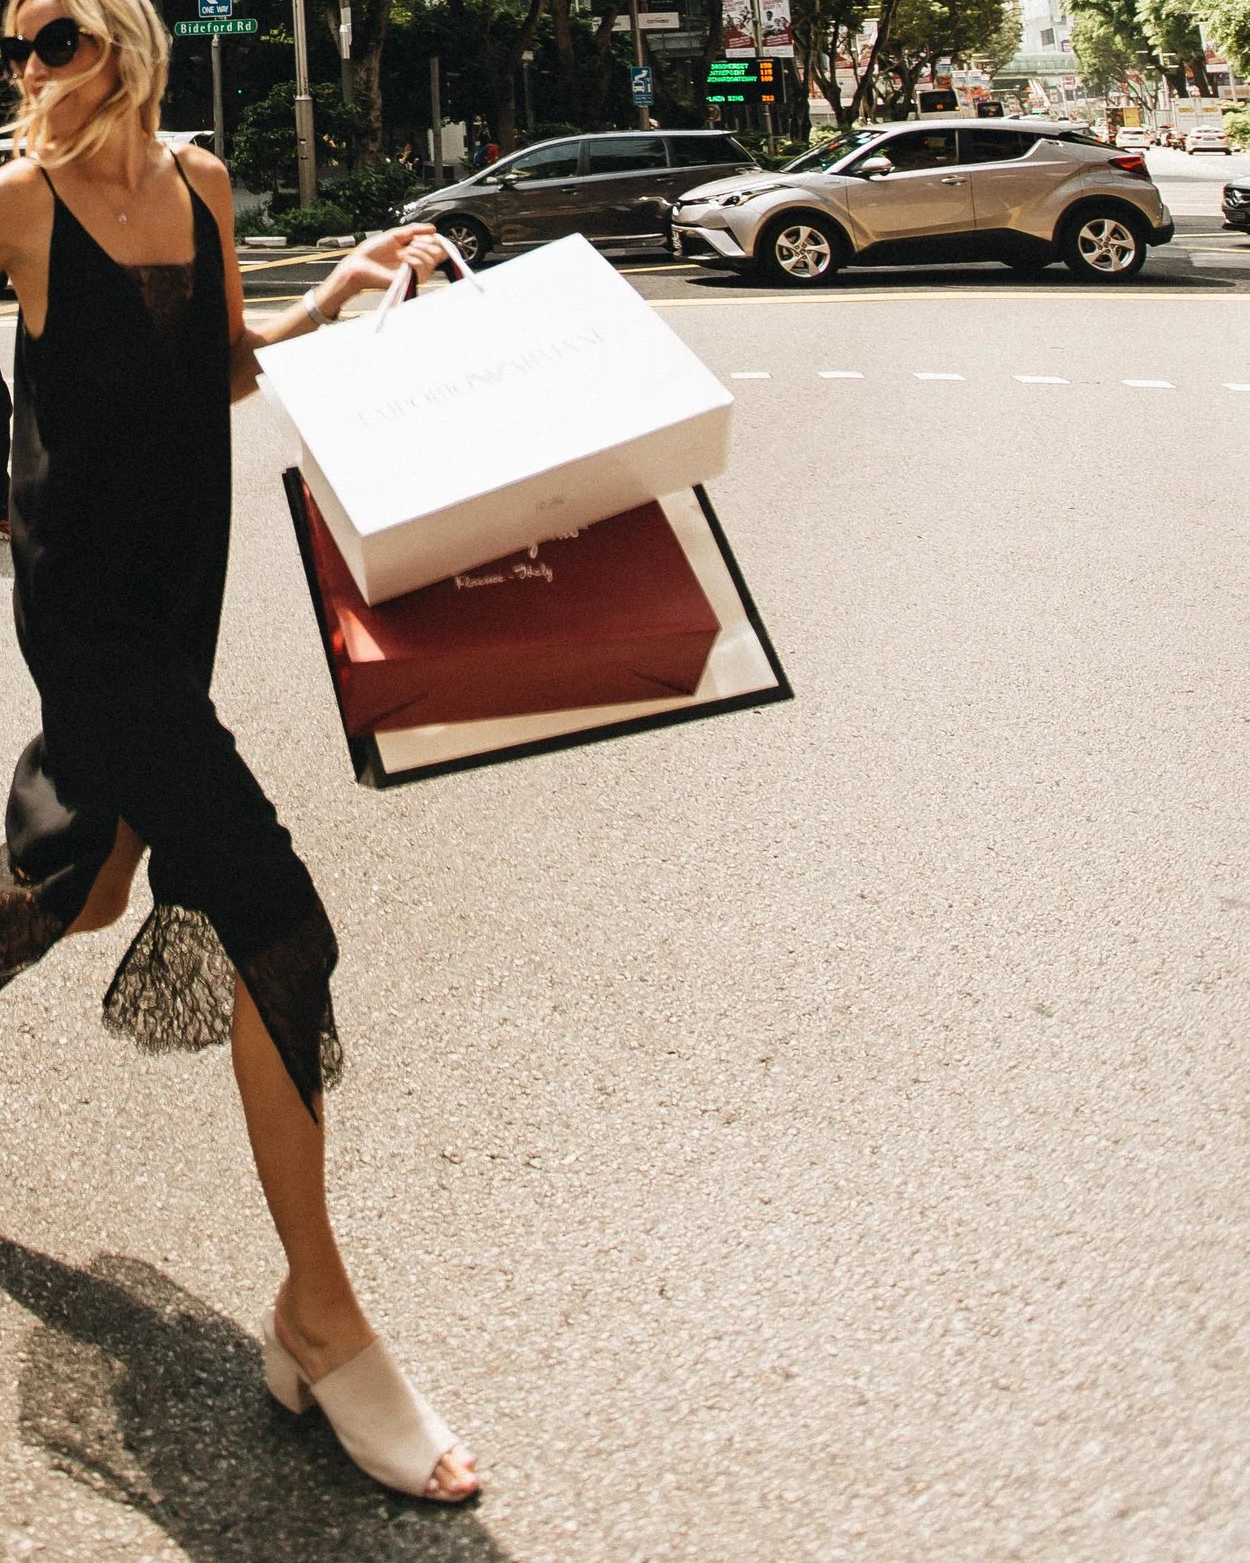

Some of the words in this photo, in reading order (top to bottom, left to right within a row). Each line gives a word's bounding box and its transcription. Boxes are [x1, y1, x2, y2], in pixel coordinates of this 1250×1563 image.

[201, 6, 215, 14] ONE
[216, 5, 229, 13] WAY
[180, 22, 233, 34] Bideford
[237, 21, 252, 32] Rd
